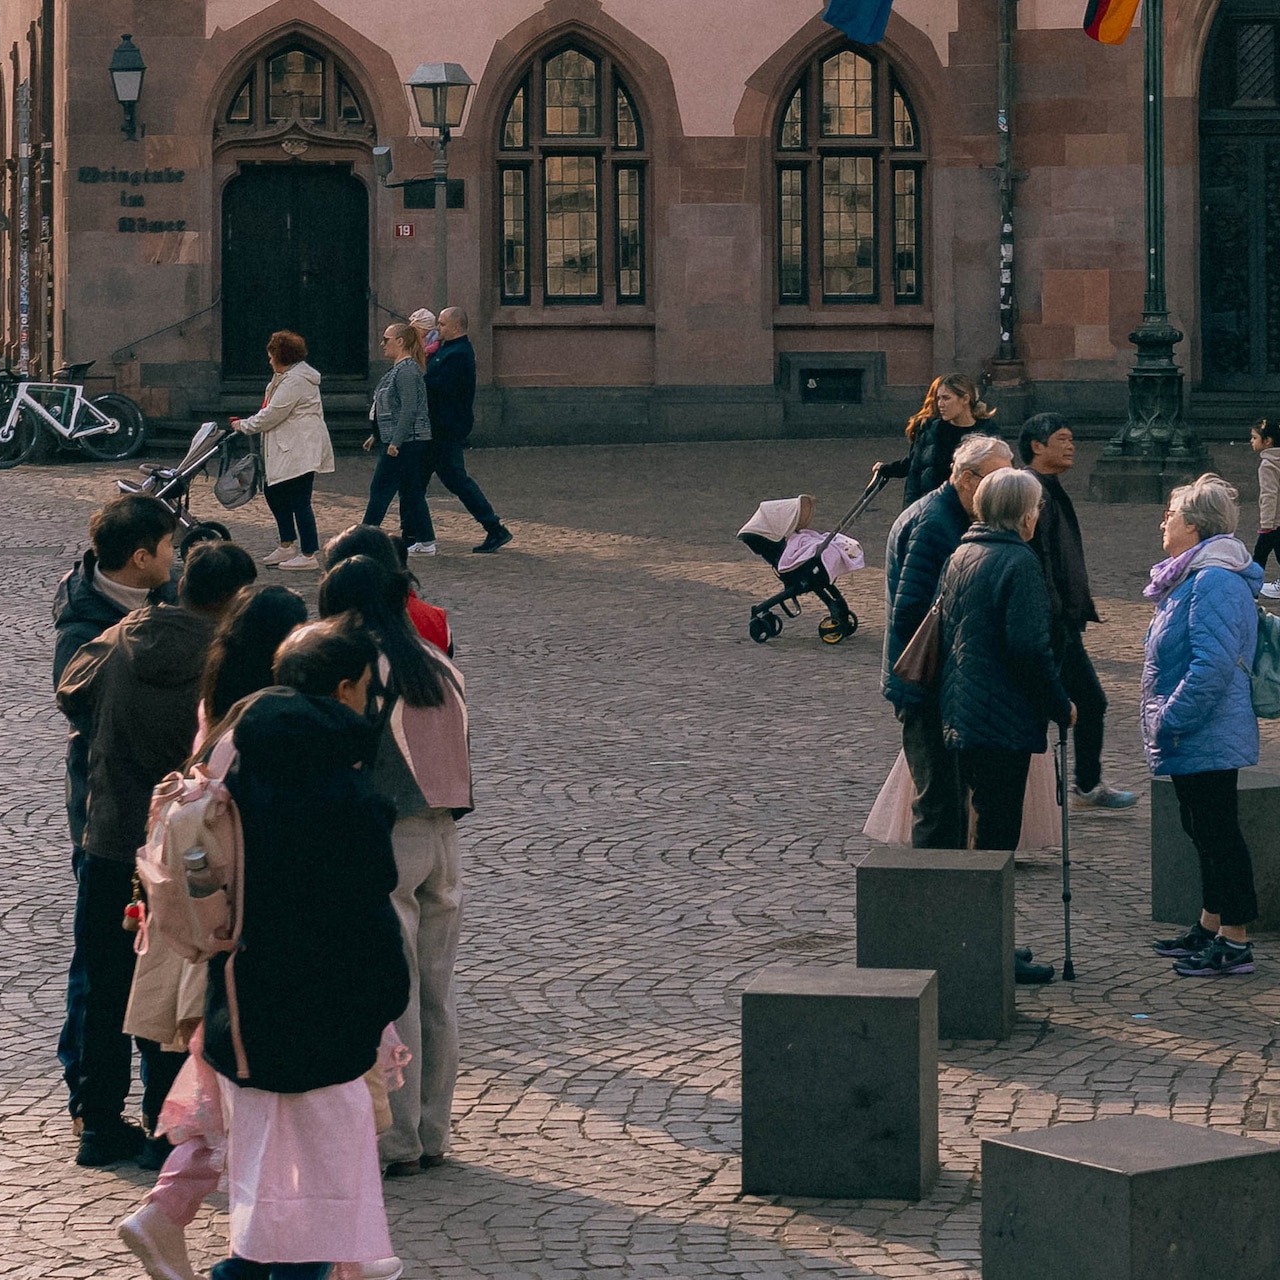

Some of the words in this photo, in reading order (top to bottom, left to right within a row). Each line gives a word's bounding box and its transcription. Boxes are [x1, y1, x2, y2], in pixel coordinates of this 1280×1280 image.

[120, 189, 145, 207] im
[118, 216, 186, 233] Römer
[398, 224, 411, 236] 19
